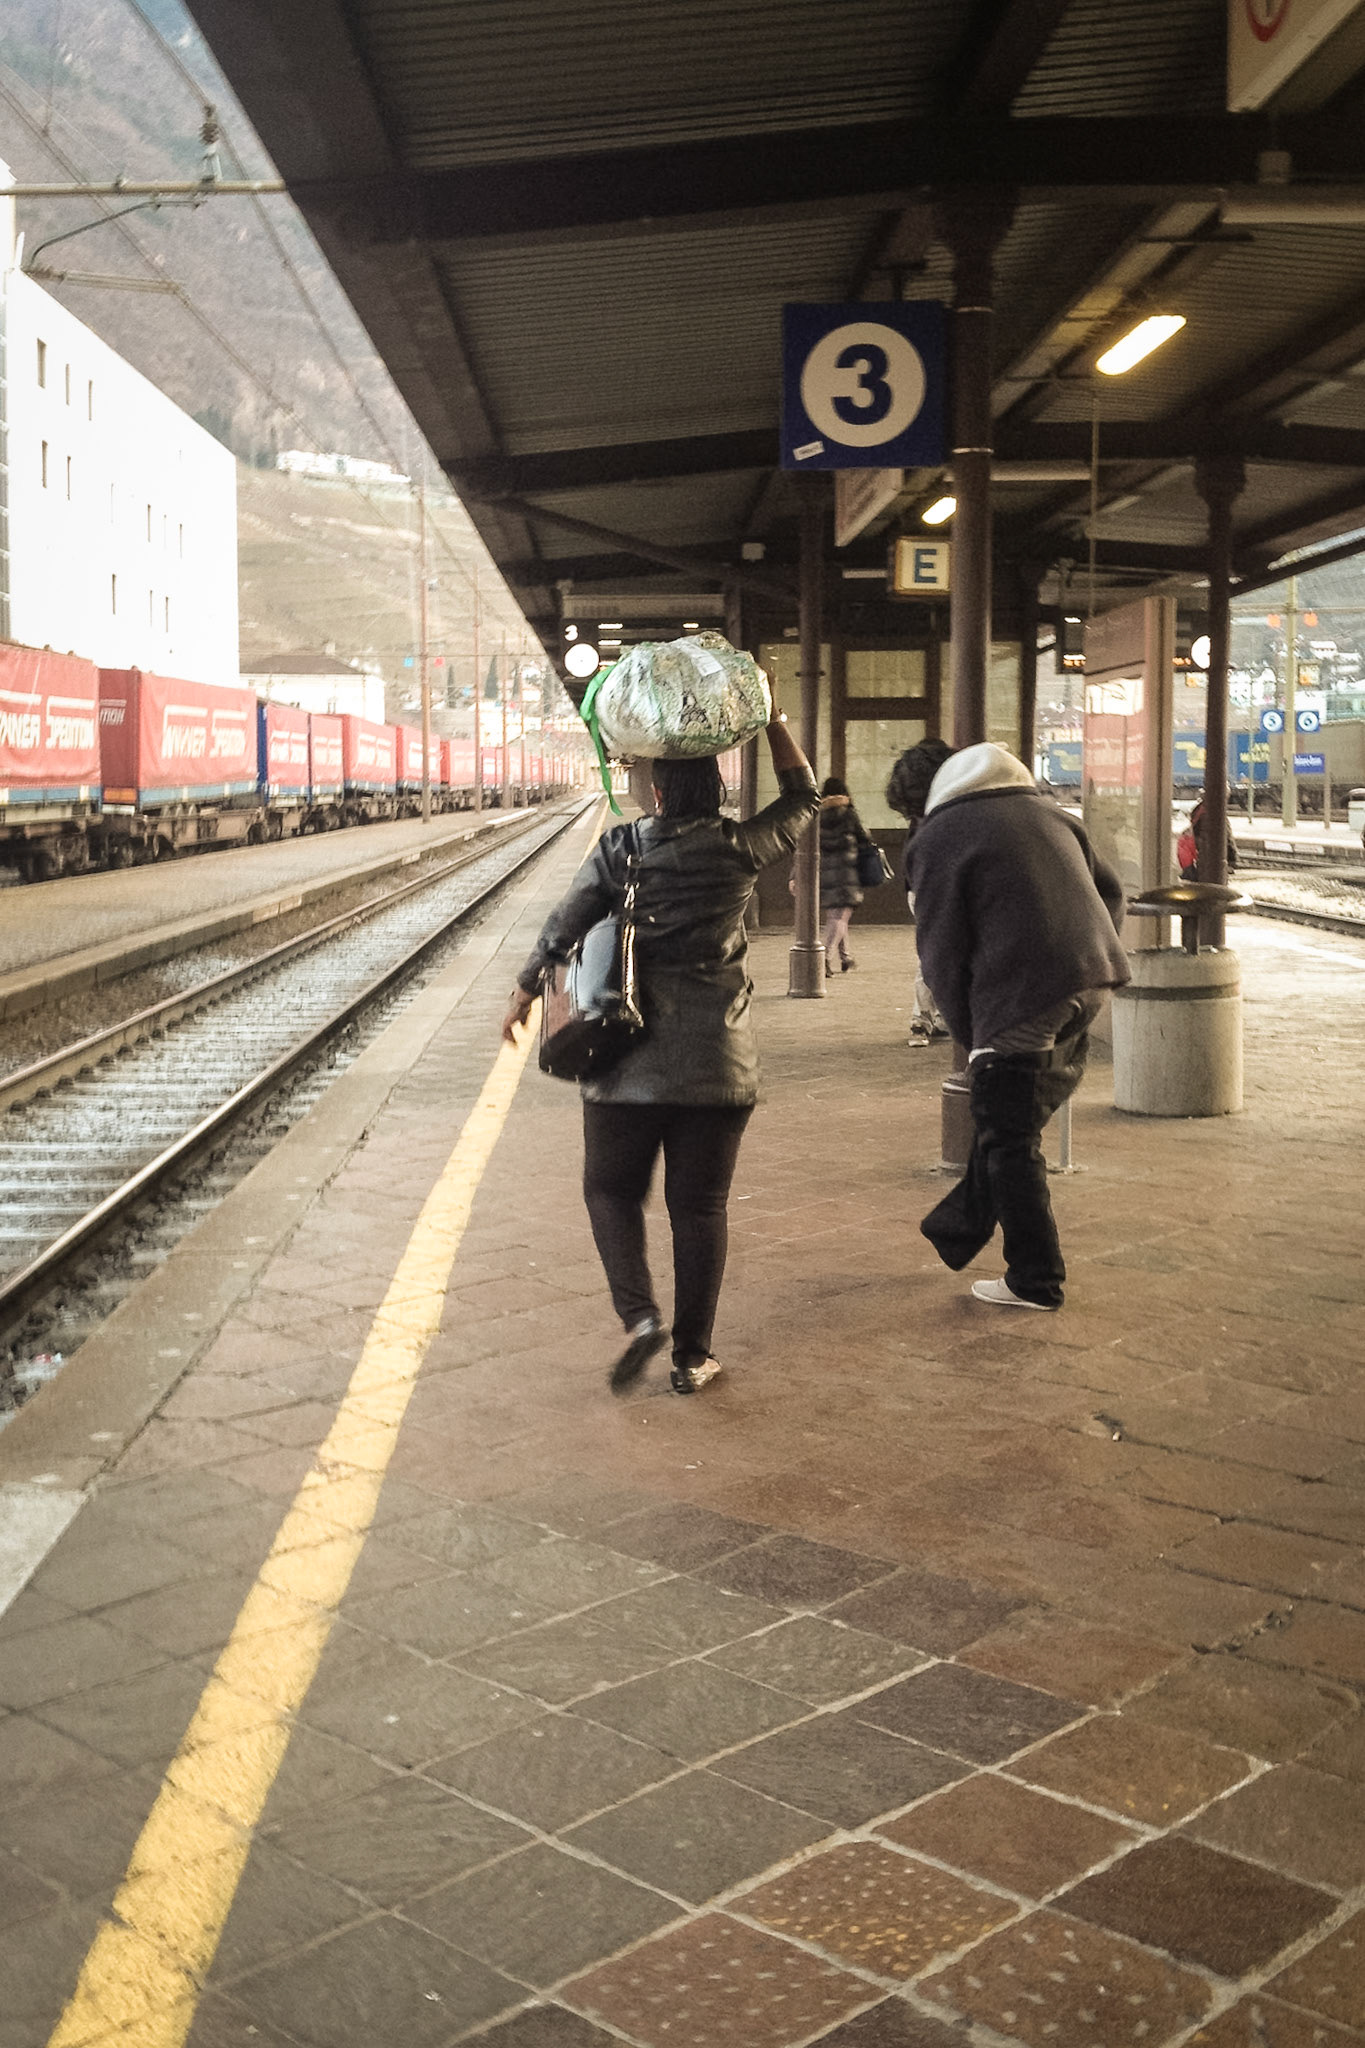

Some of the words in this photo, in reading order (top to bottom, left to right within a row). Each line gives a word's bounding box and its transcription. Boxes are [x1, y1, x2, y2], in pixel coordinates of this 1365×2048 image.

[832, 342, 894, 426] 3
[913, 547, 939, 584] E
[564, 624, 579, 642] 3
